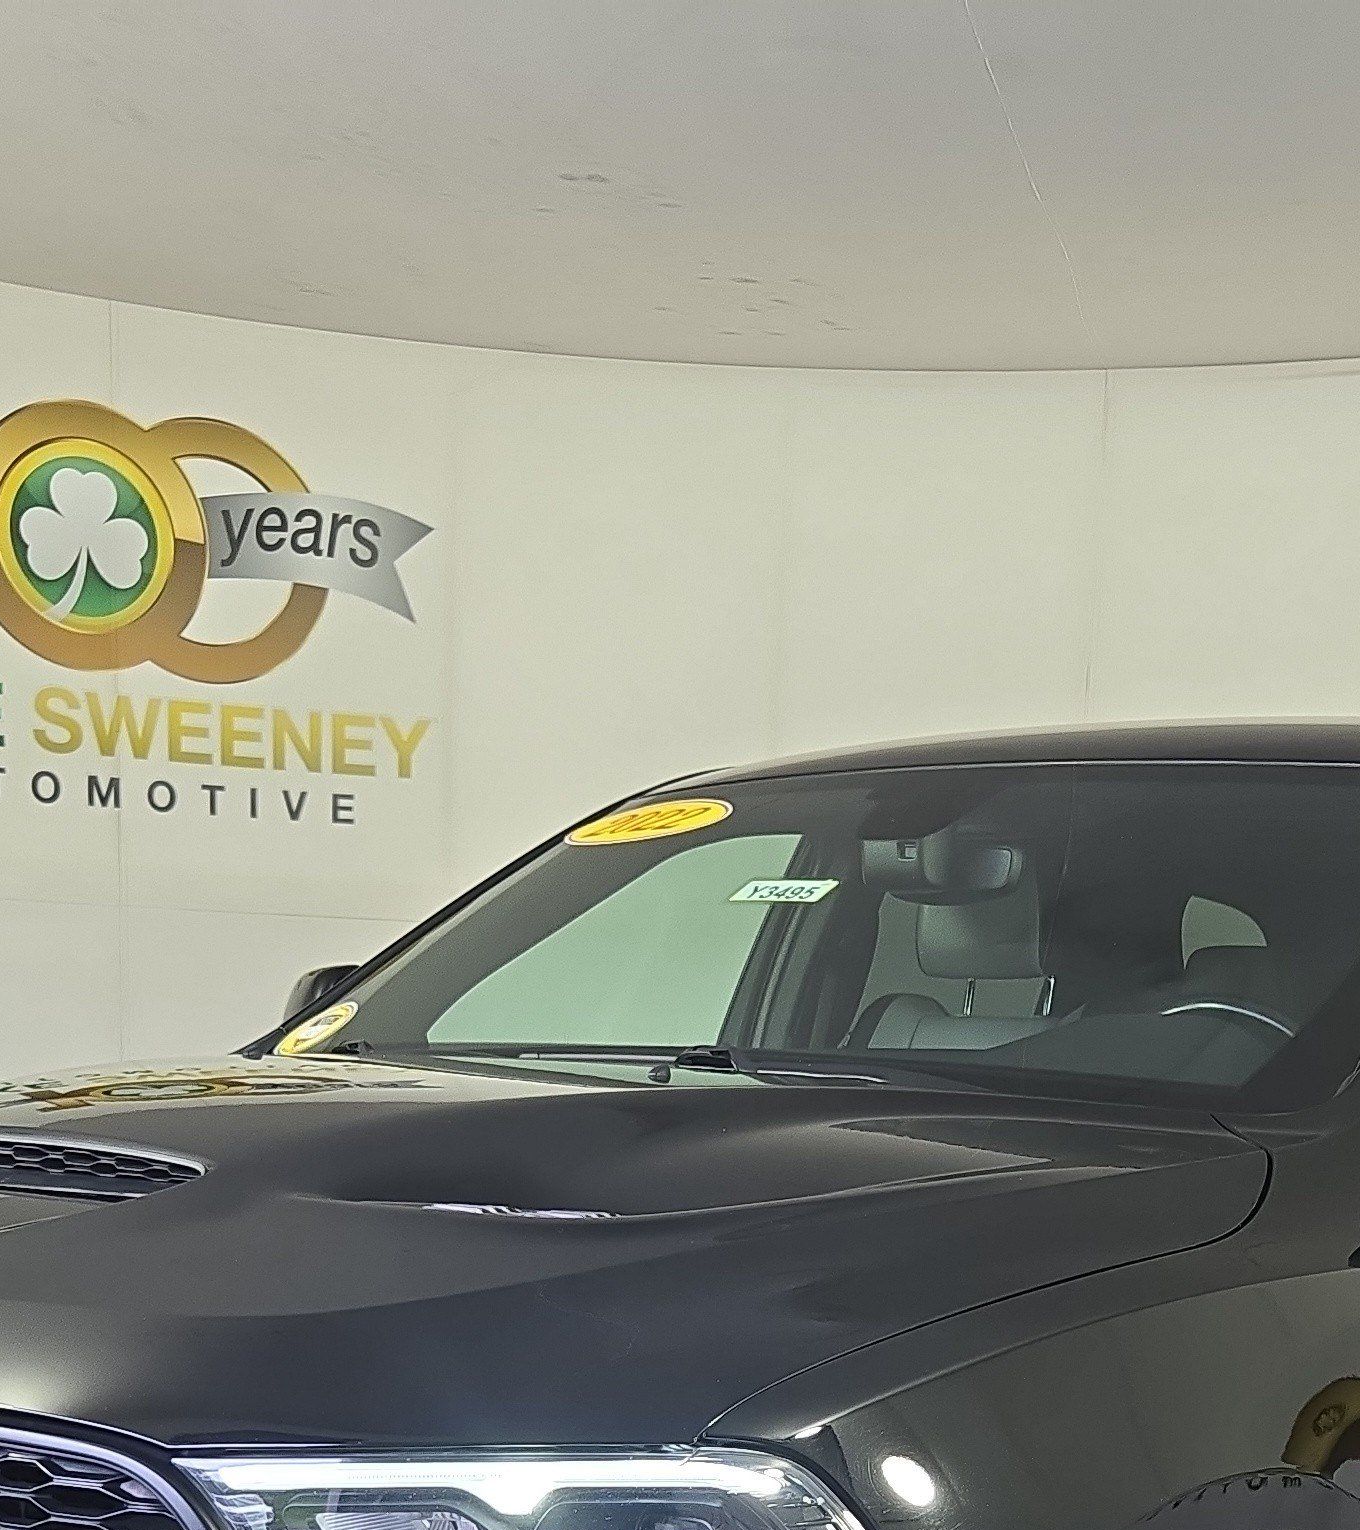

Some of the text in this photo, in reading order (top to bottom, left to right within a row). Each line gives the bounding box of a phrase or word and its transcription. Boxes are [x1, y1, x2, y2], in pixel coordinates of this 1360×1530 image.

[220, 504, 380, 568] years
[31, 686, 433, 779] SWEENEY
[580, 806, 712, 839] 2022
[746, 884, 821, 900] Y3495
